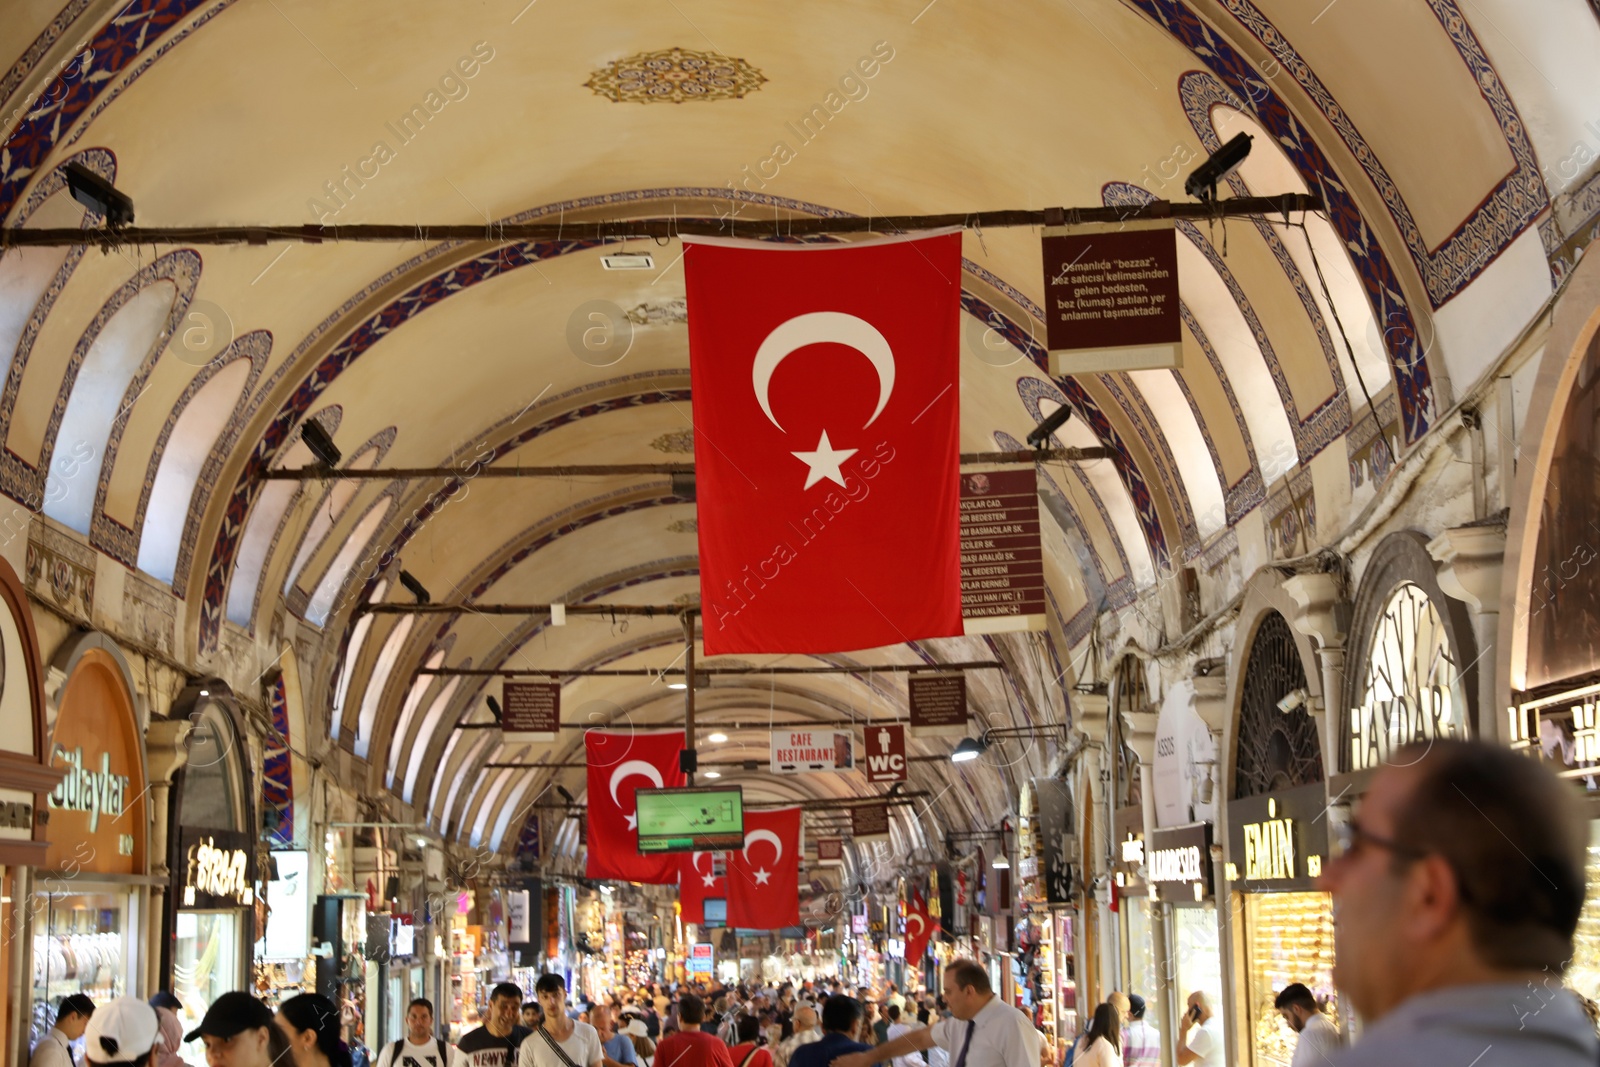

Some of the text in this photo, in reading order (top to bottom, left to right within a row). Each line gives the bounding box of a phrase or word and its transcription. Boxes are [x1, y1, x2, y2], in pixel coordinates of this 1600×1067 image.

[1052, 269, 1169, 285] bez satıcısı kelimesinden
[1074, 283, 1148, 298] gelen bedesten,
[1057, 295, 1166, 310] bez (kumaş) satılan yer
[1061, 306, 1164, 321] anlamını taşımaktadır.
[971, 511, 1007, 522] BEDESTENİ
[1013, 524, 1024, 533] SK.
[984, 540, 995, 548] SK.
[1005, 552, 1016, 560] SK.
[972, 565, 1008, 576] BEDESTENİ
[1001, 592, 1013, 600] WC
[790, 733, 812, 746] CAFE
[777, 748, 834, 762] RESTAURANT
[868, 754, 904, 772] WC
